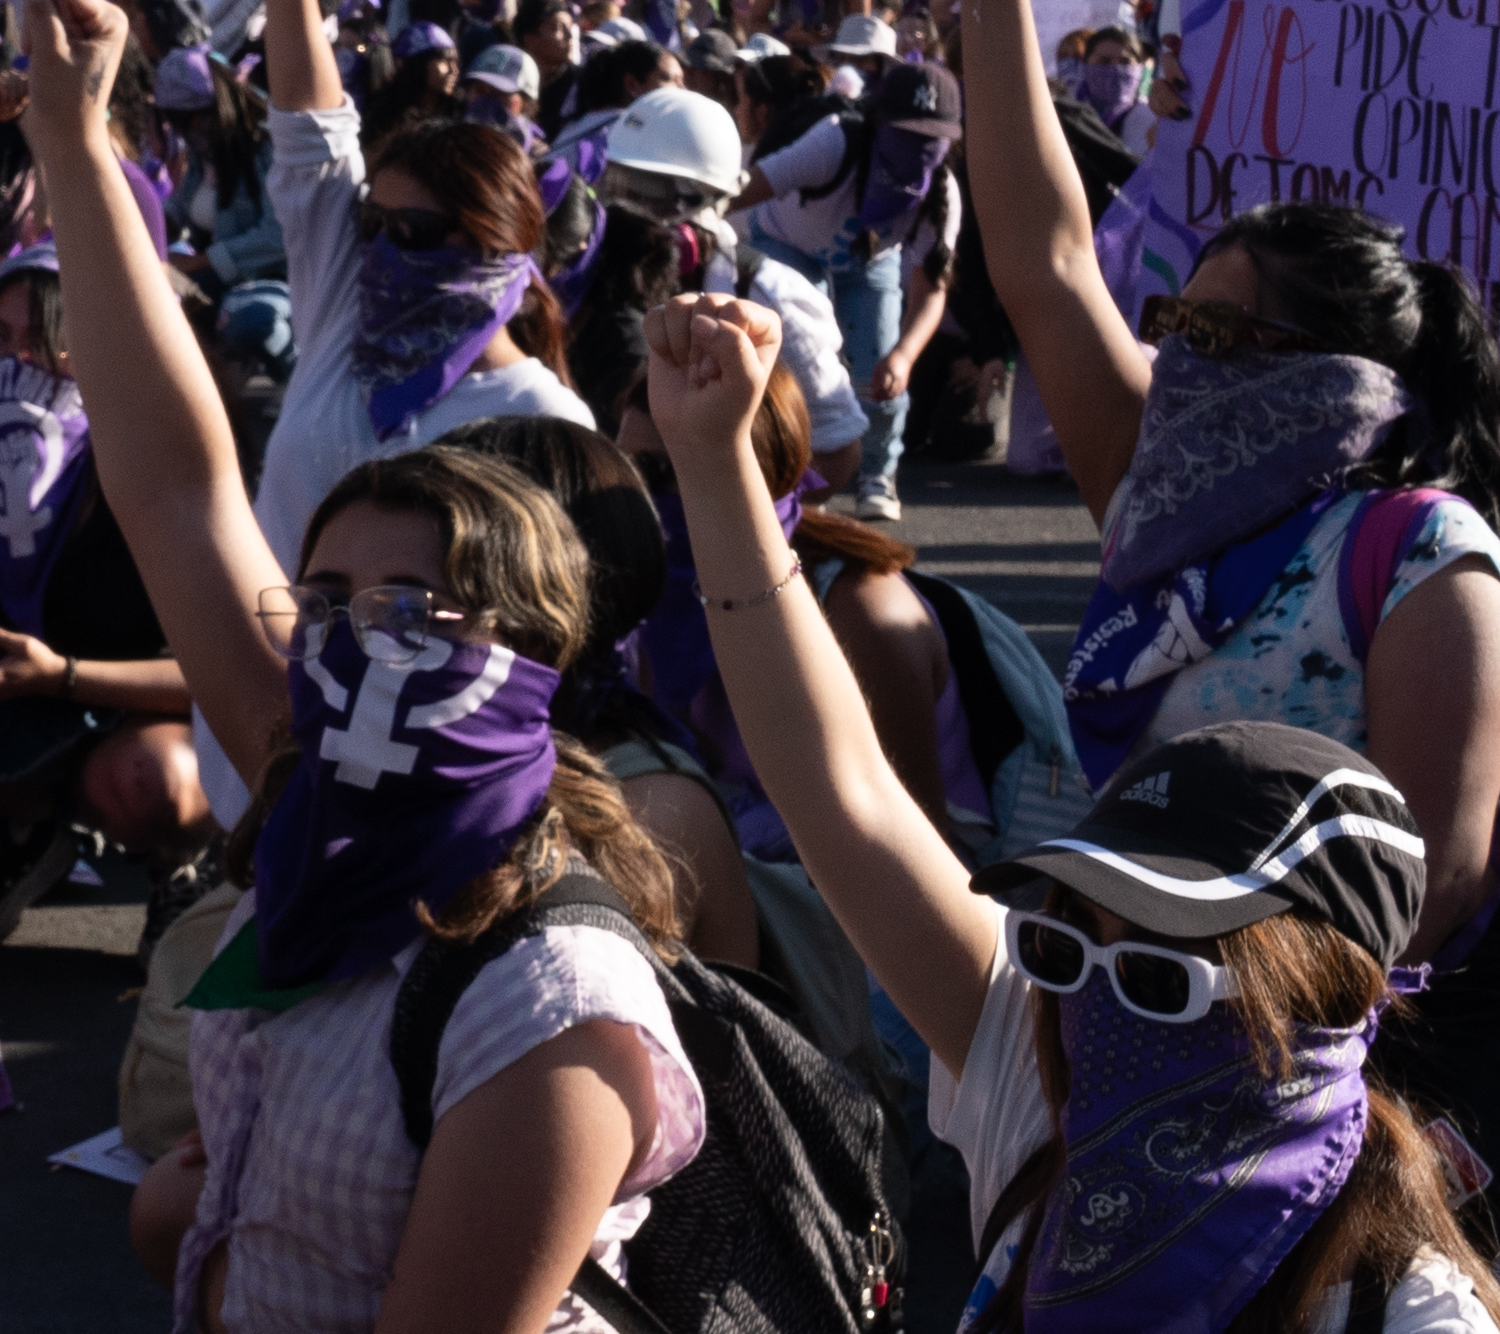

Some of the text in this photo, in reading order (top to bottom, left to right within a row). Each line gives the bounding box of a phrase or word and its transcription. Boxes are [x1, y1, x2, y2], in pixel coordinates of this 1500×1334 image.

[1192, 0, 1316, 159] NO
[1334, 2, 1438, 100] PIDE
[1119, 789, 1170, 808] adidas
